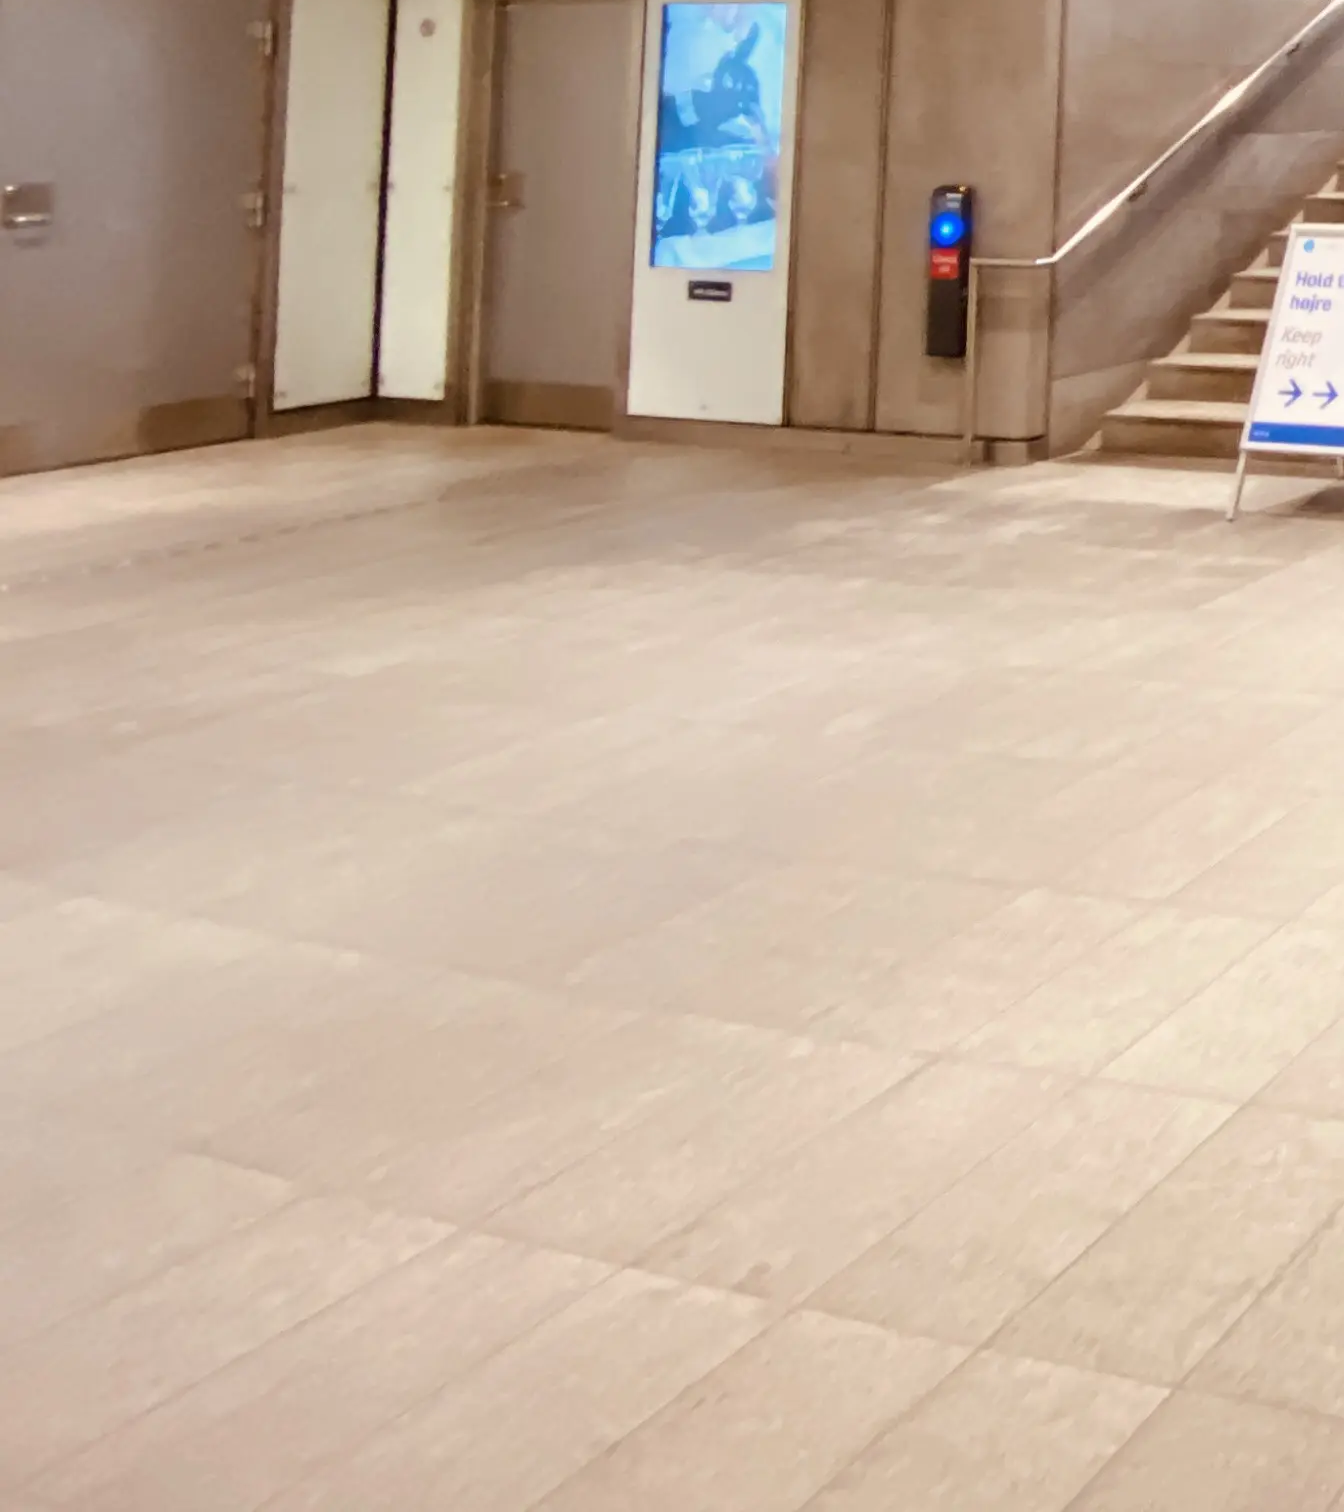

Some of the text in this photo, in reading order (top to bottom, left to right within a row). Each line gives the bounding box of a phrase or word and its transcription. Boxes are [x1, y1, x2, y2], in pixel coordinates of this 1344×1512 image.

[1295, 271, 1334, 289] Hold
[1281, 327, 1323, 346] Keep
[1275, 348, 1317, 370] right
